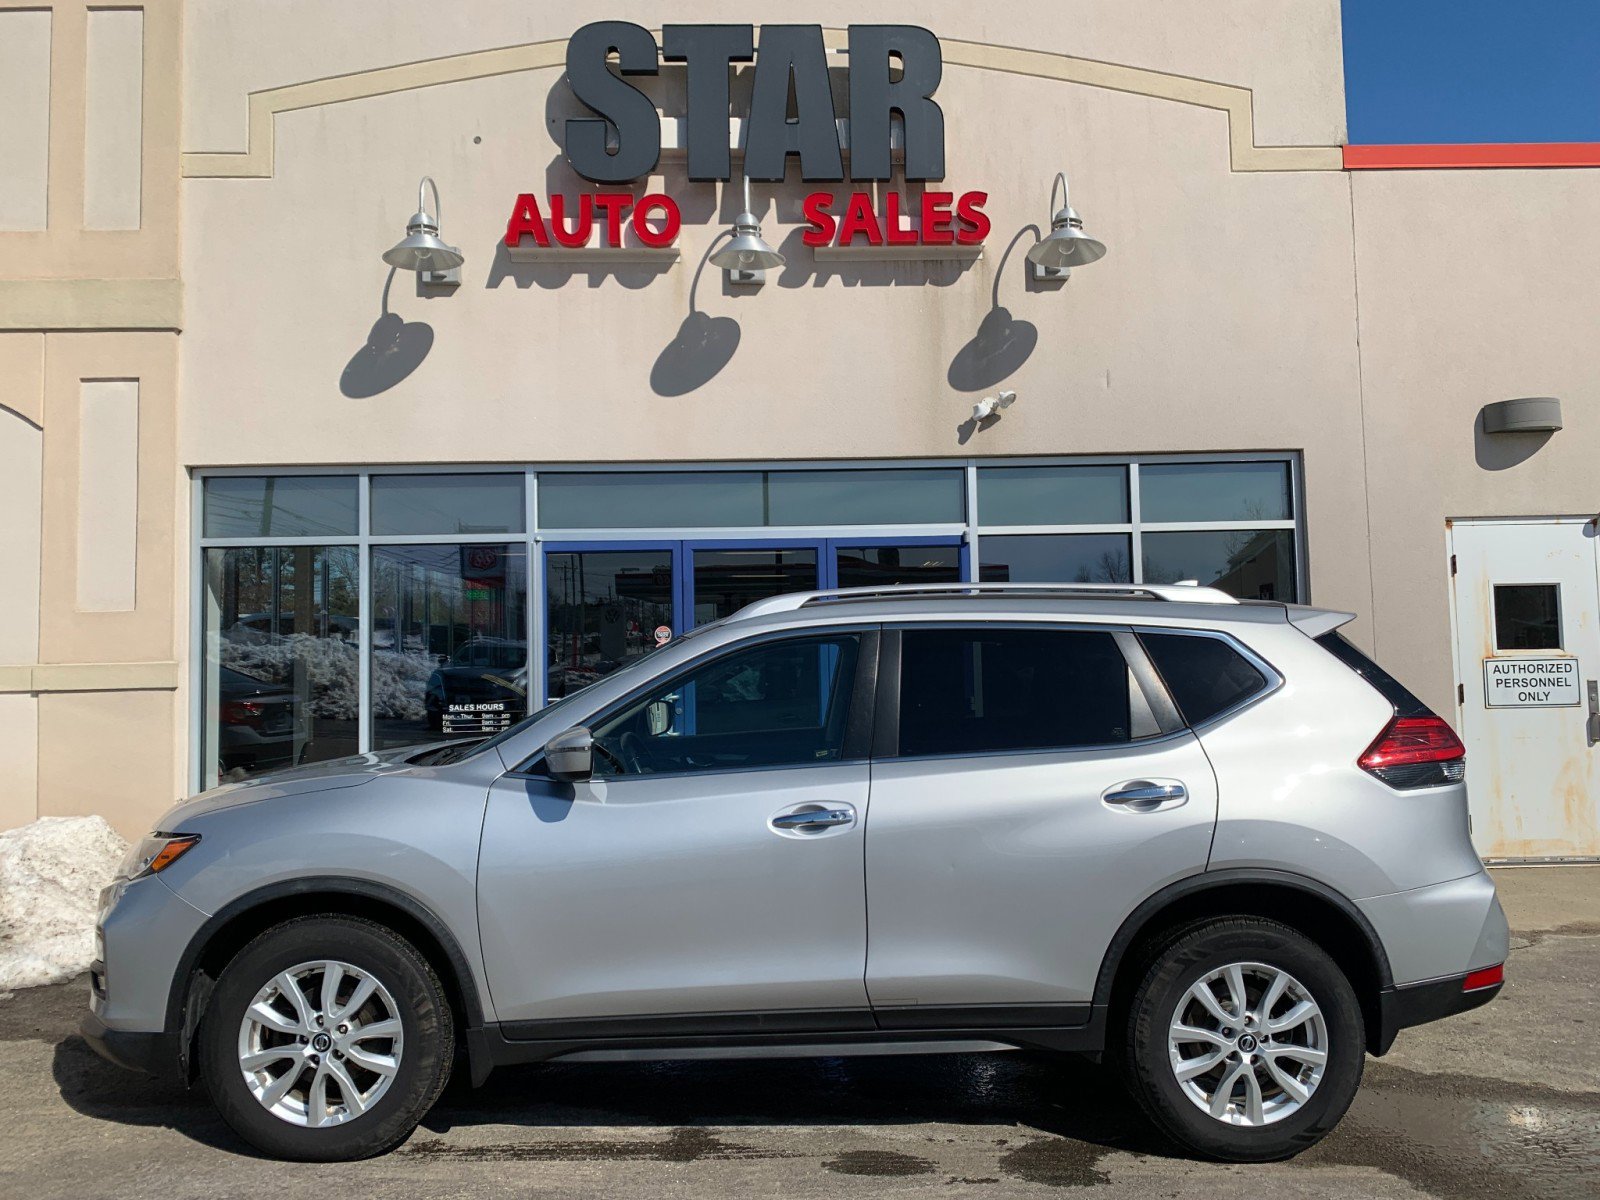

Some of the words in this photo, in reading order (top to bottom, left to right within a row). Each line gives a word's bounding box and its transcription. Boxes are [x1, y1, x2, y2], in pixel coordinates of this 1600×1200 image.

[565, 20, 945, 184] STAR
[505, 193, 681, 248] AUTO
[802, 191, 991, 247] SALES
[1493, 663, 1573, 675] AUTHORIZED
[1496, 677, 1572, 688] PERSONNEL
[1518, 691, 1551, 702] ONLY
[449, 704, 475, 712] SALES
[476, 703, 504, 711] HOURS
